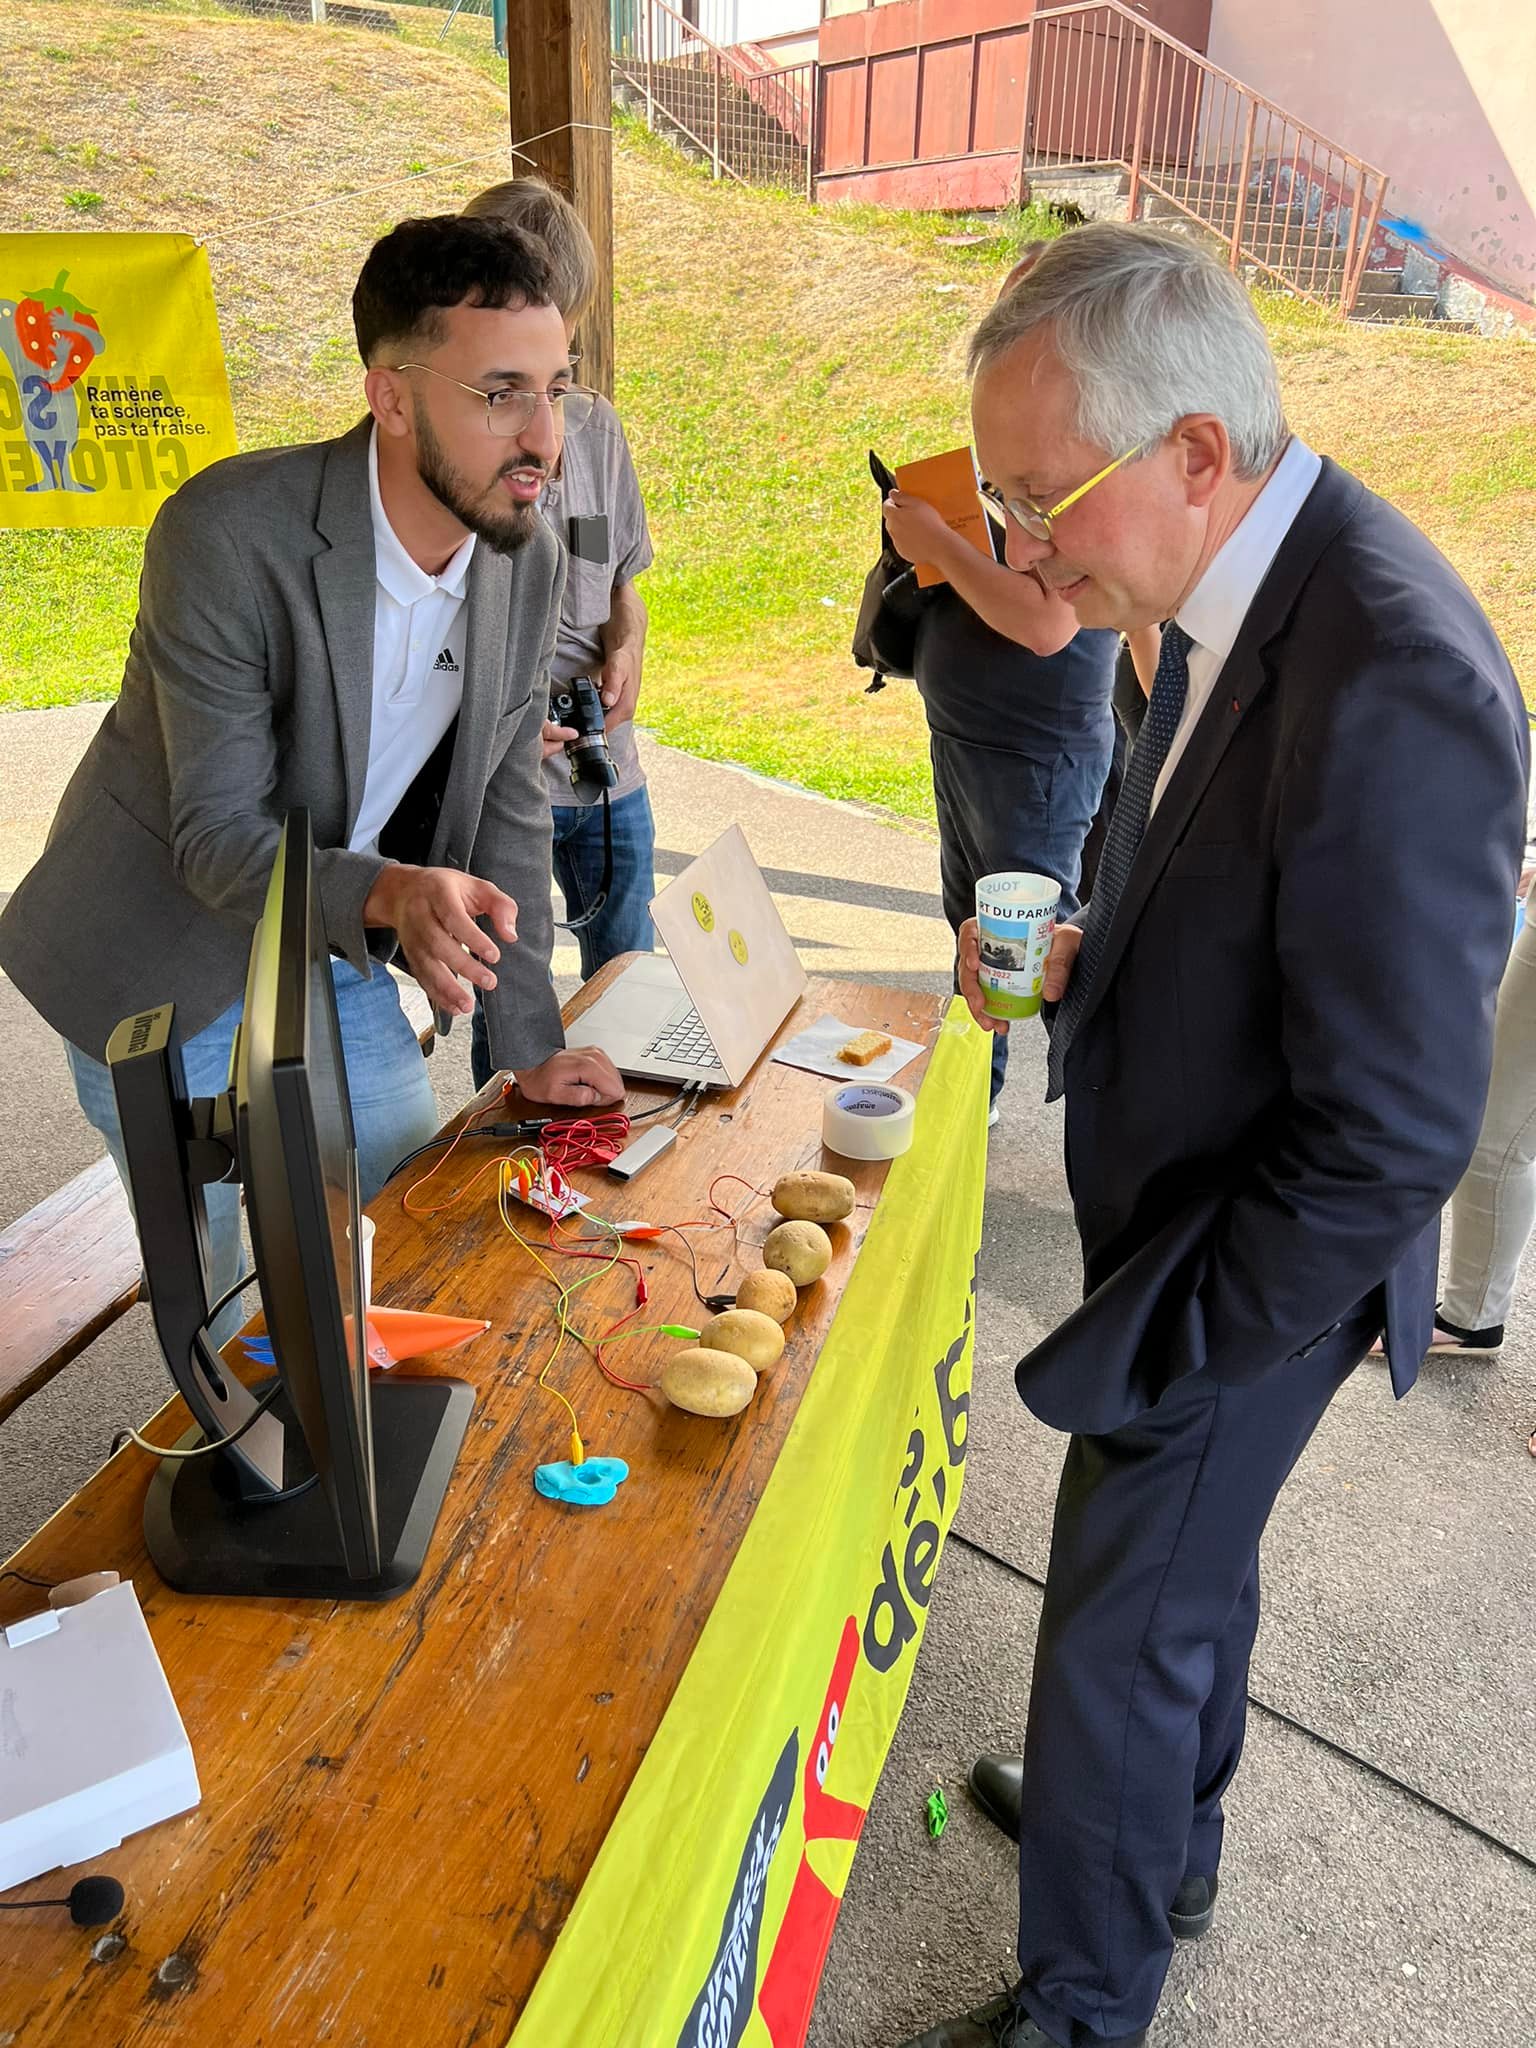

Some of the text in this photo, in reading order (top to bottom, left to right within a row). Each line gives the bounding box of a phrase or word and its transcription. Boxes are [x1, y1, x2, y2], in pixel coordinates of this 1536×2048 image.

[87, 386, 163, 402] Ramène
[90, 403, 191, 420] ta science,
[95, 420, 211, 439] pas ta fraise.
[993, 906, 1012, 919] DU
